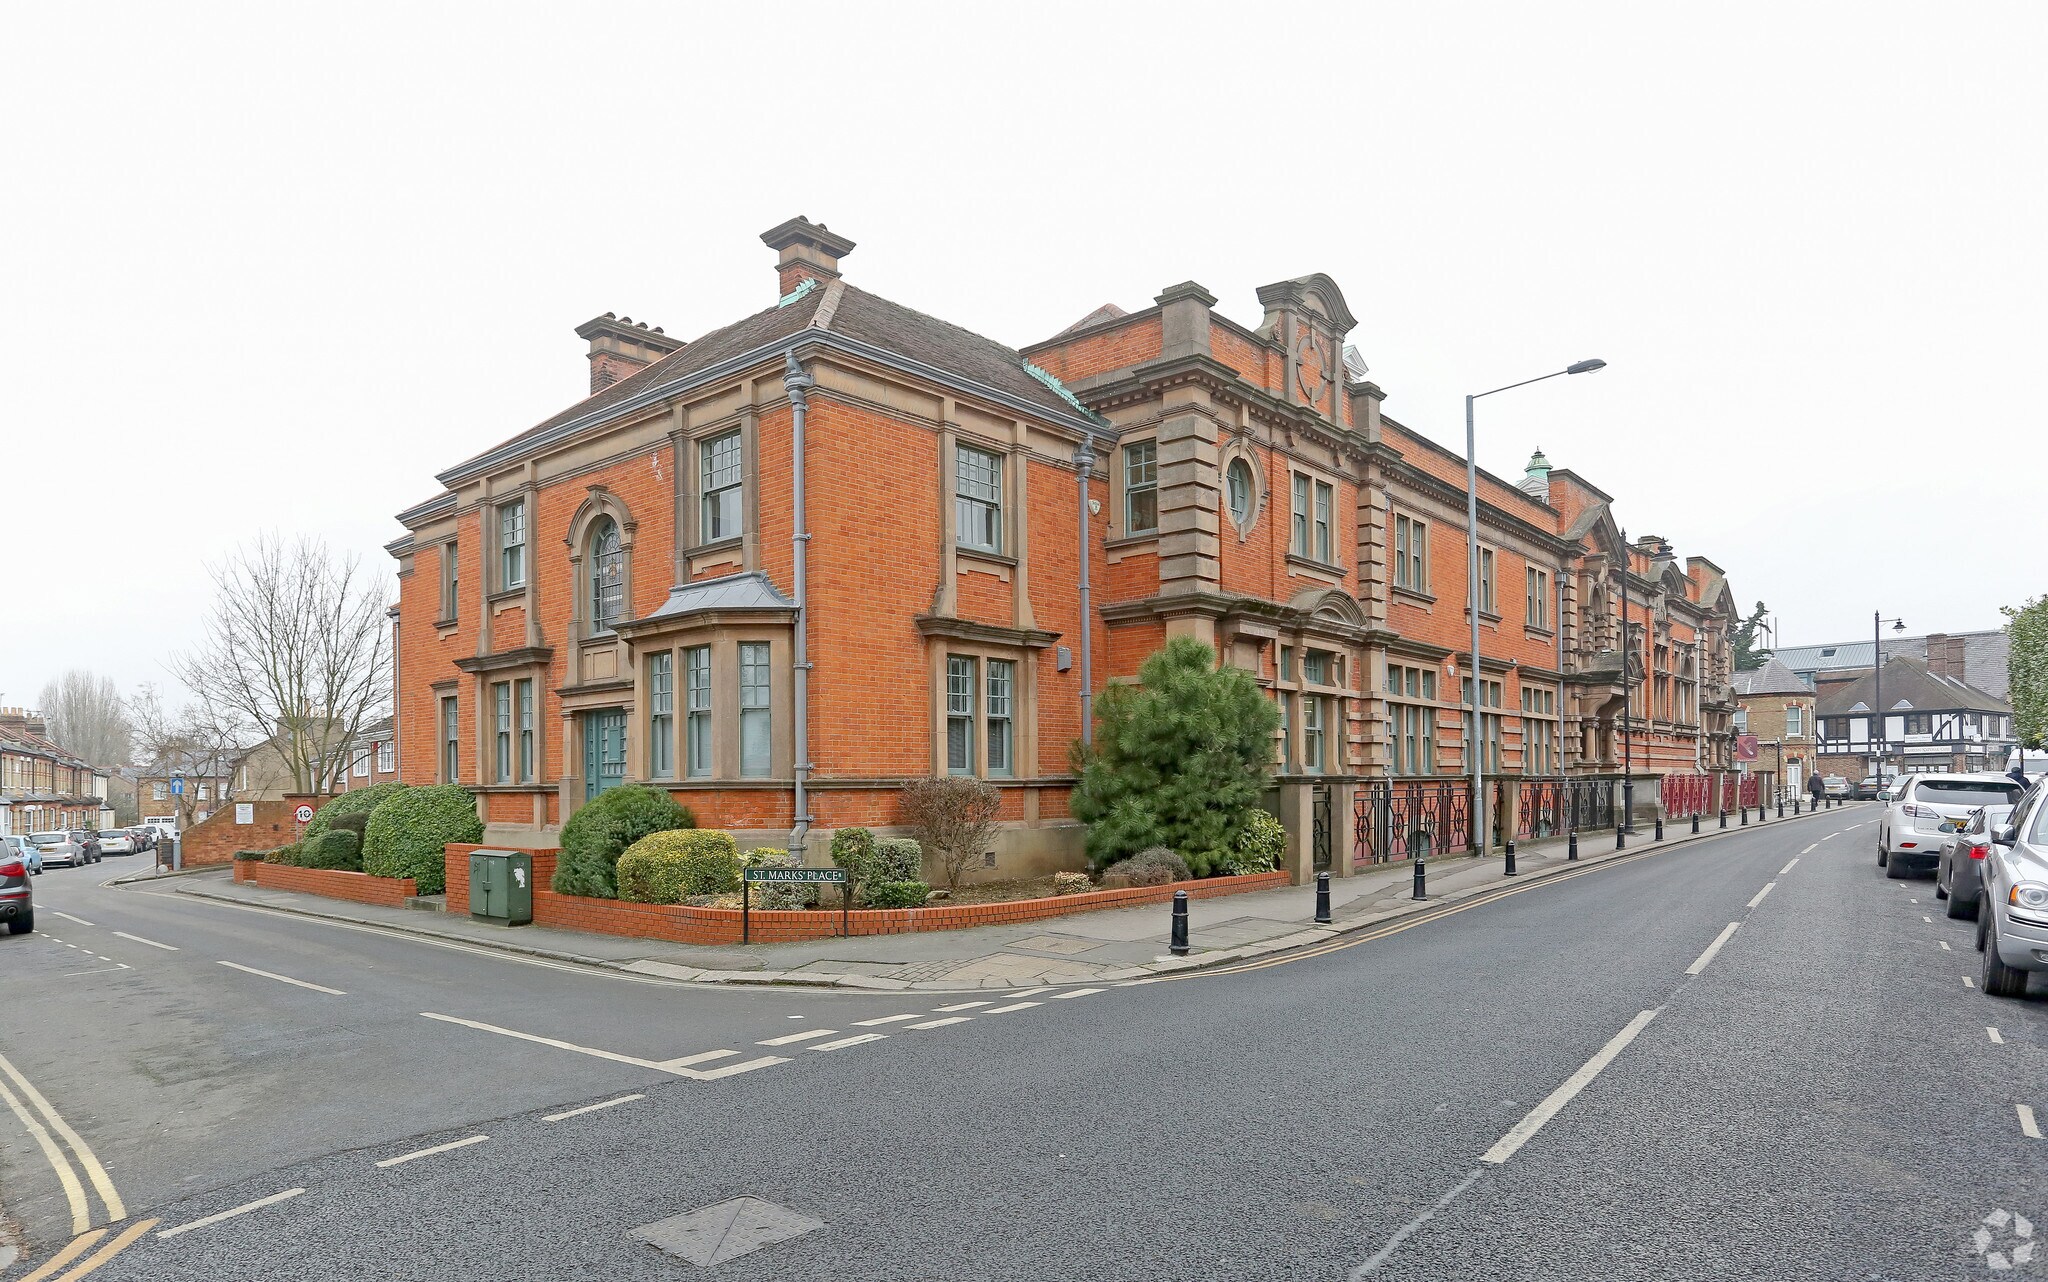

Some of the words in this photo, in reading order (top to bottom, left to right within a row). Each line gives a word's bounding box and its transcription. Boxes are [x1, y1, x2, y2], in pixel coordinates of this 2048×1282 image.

[298, 809, 311, 818] 10
[752, 870, 766, 880] ST.
[807, 870, 839, 881] PLACE
